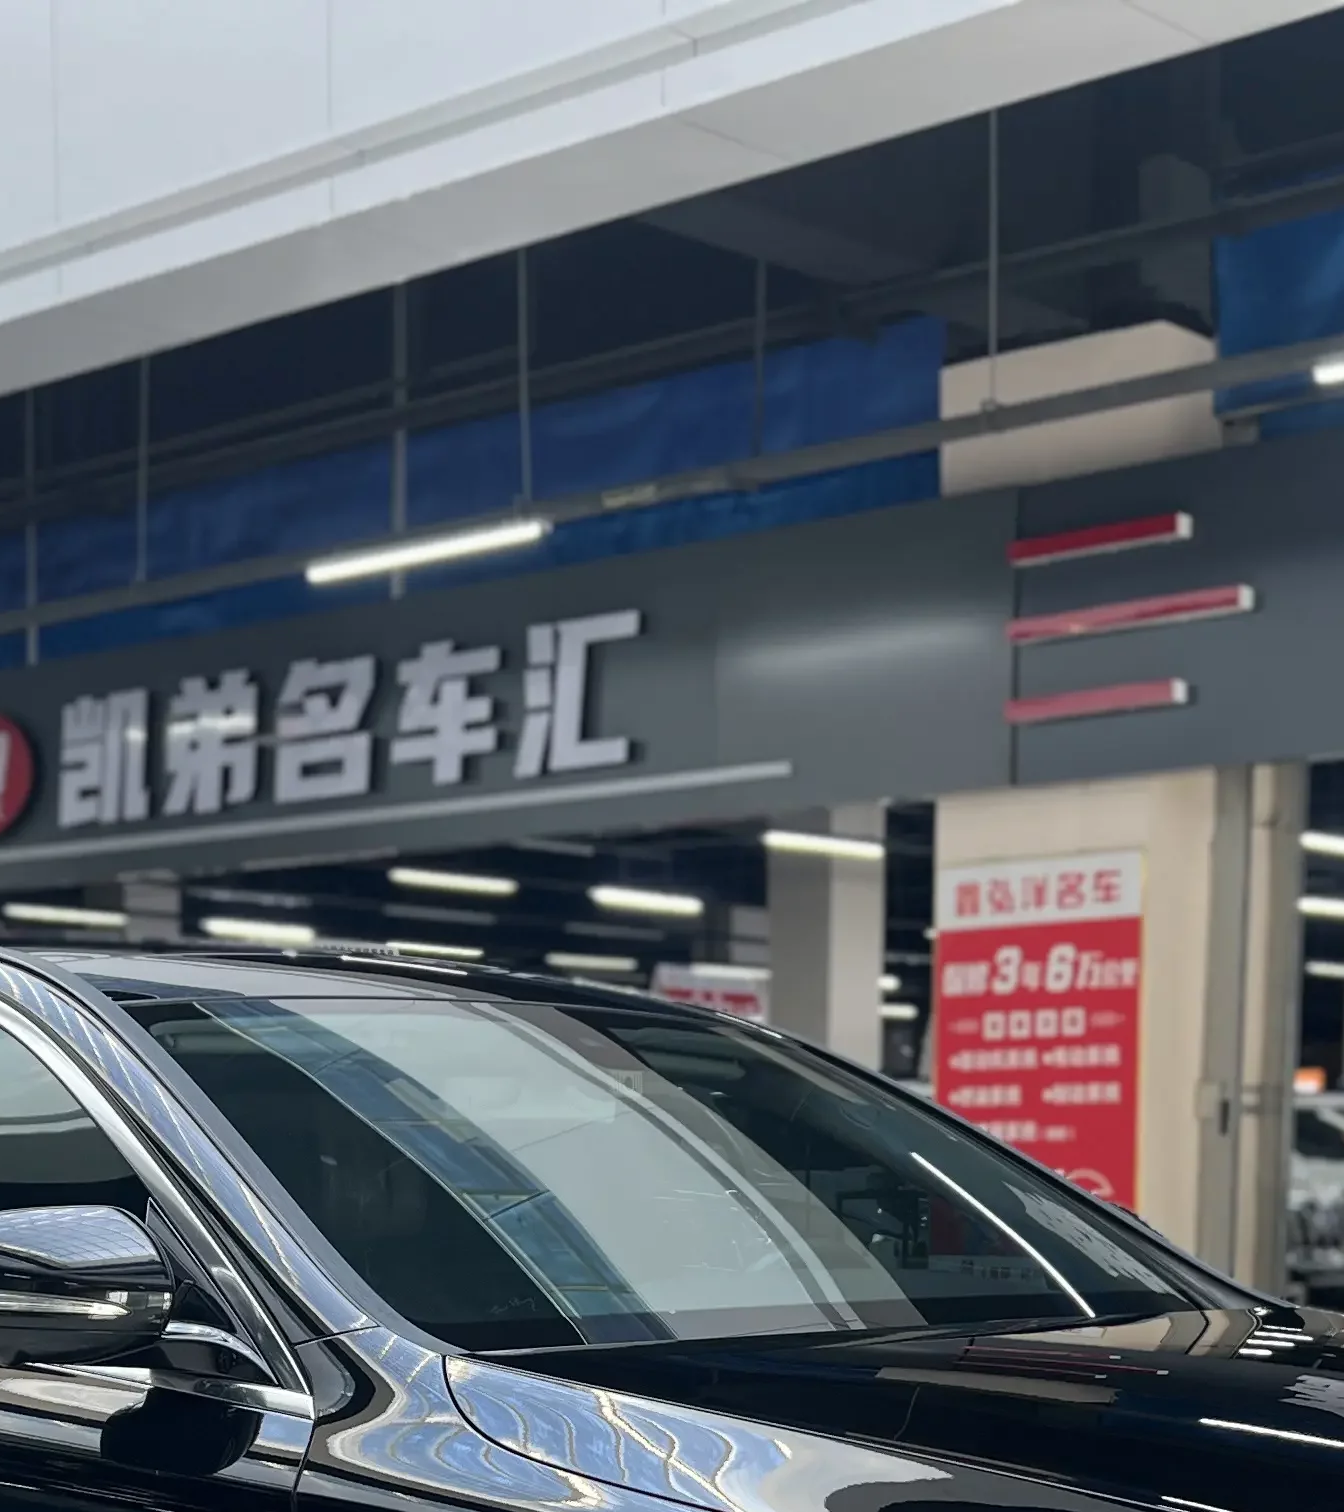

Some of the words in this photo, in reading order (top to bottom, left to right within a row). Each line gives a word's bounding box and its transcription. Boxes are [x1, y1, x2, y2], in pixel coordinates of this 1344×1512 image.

[58, 610, 639, 827] 凯弟名车汇
